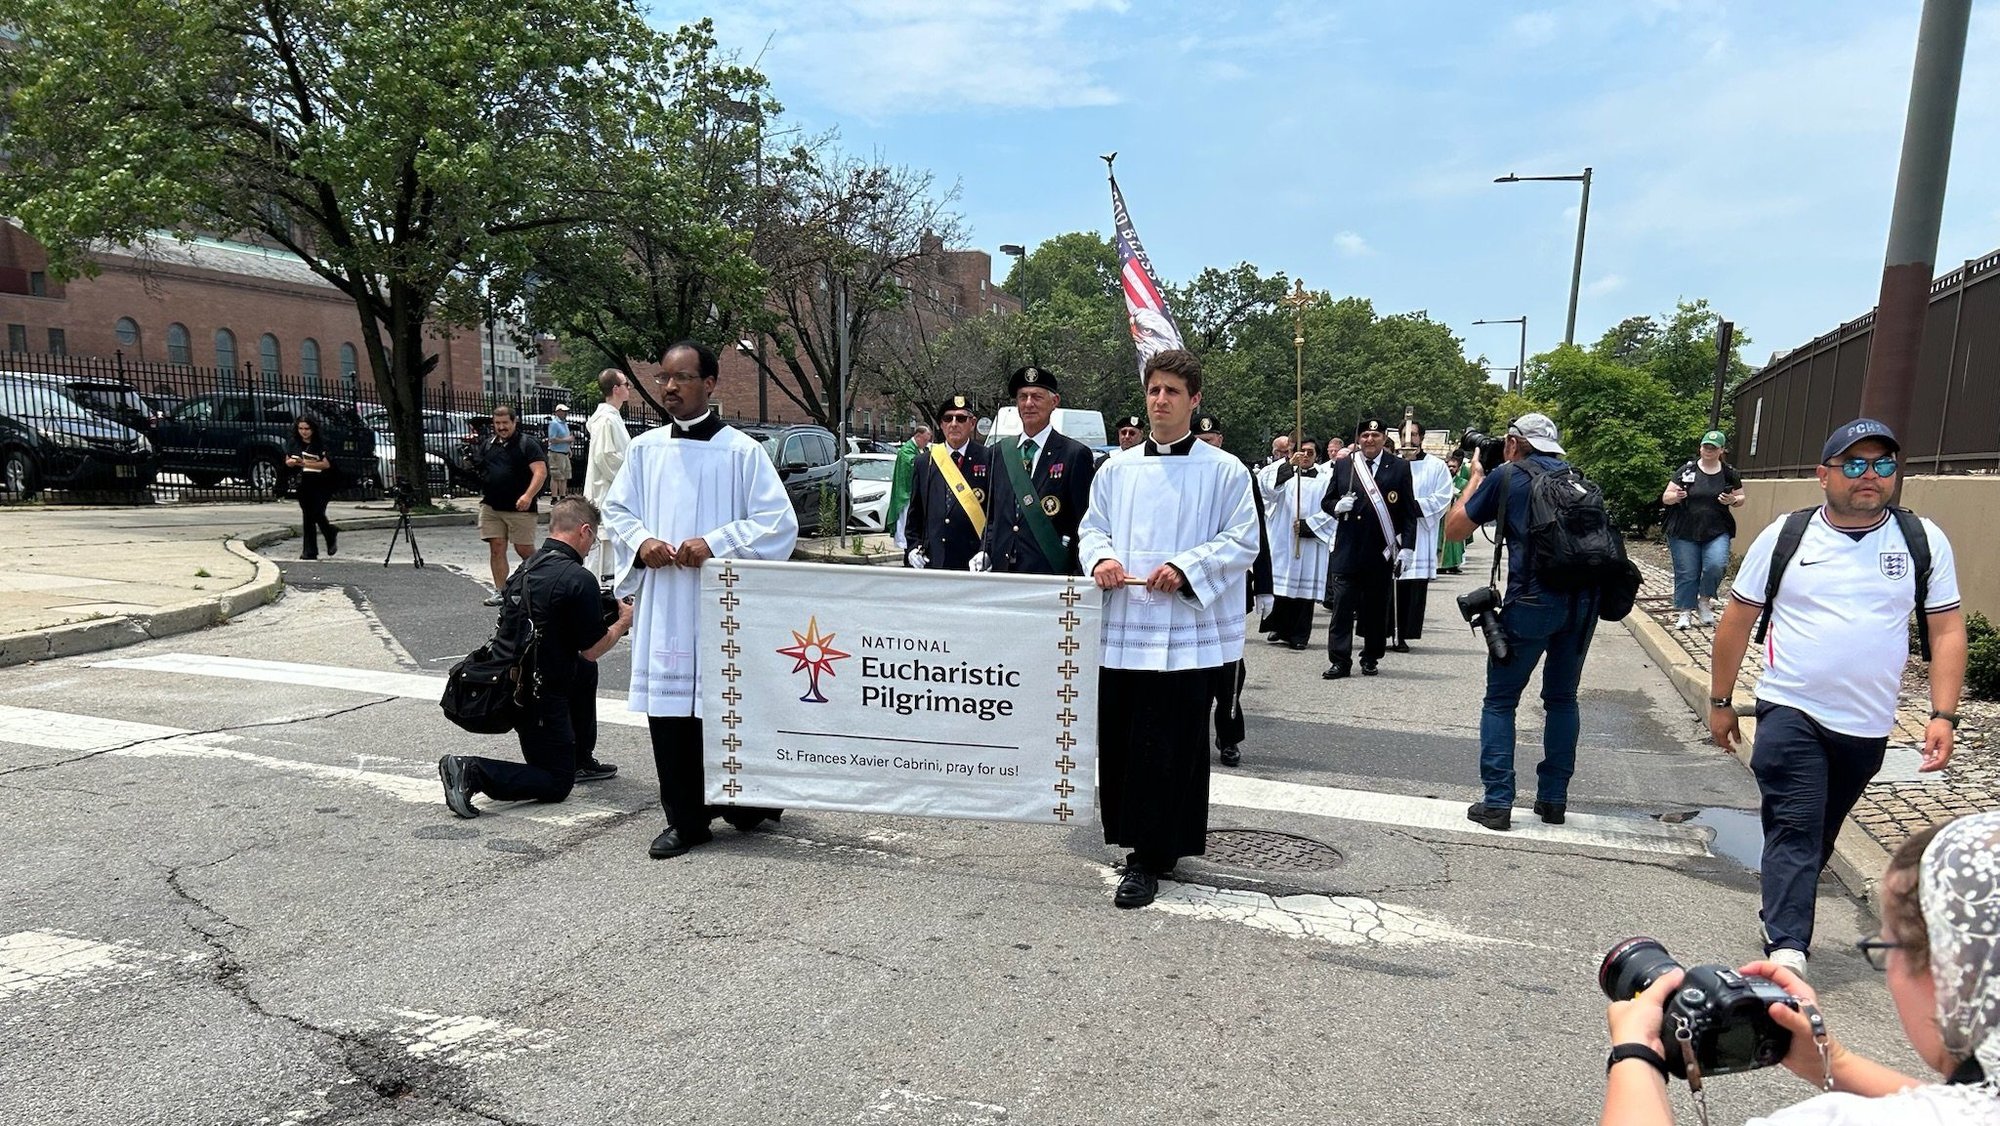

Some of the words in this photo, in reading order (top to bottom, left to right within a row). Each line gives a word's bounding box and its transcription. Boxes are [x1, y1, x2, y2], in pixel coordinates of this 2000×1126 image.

[861, 635, 951, 654] NATIONAL
[861, 656, 1021, 688] Eucharistic
[861, 684, 1014, 722] Pilgrimage
[776, 748, 793, 761] St.
[797, 750, 847, 765] Frances
[850, 754, 890, 768] Xavier
[893, 757, 943, 773] Cabrini,
[946, 763, 975, 776] pray
[977, 762, 996, 775] for
[999, 766, 1019, 777] us!
